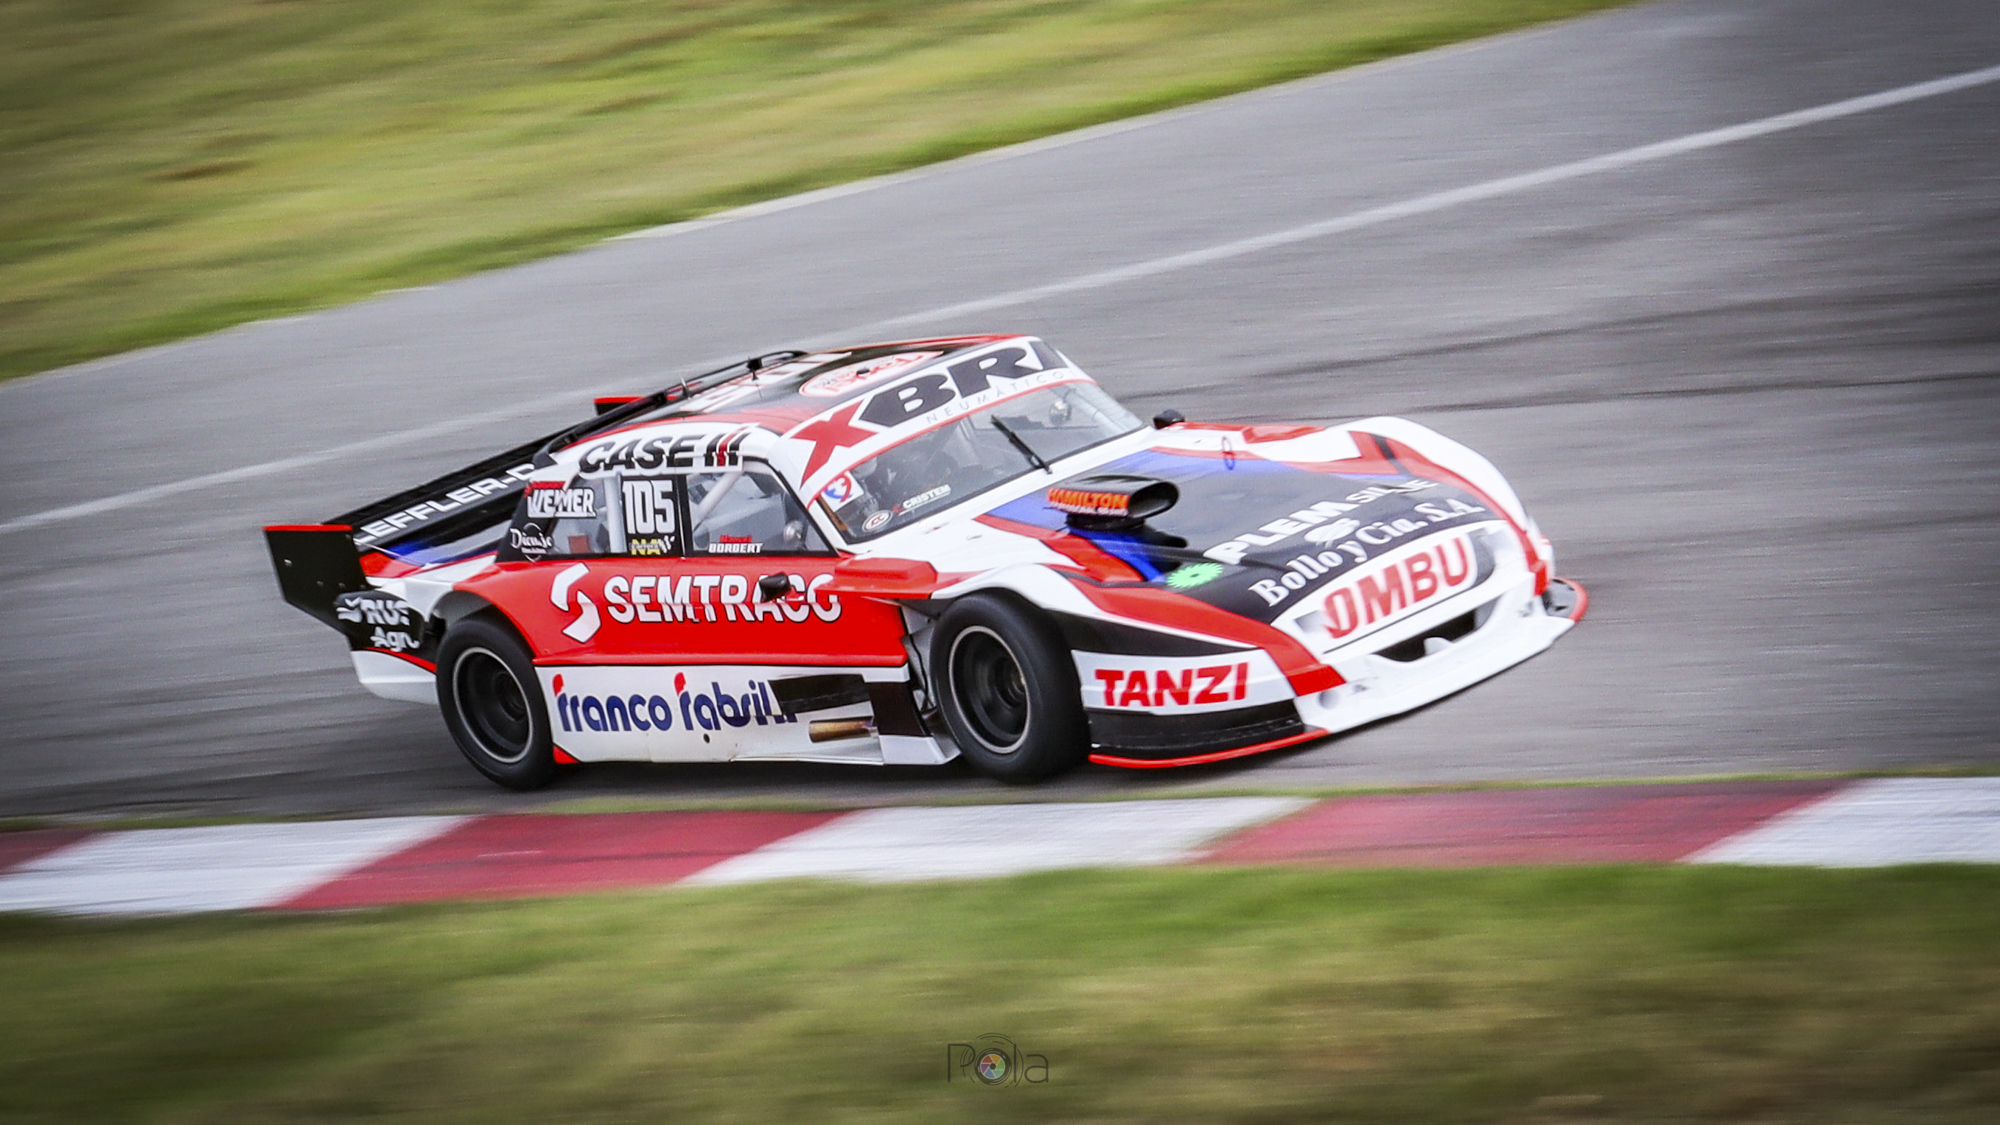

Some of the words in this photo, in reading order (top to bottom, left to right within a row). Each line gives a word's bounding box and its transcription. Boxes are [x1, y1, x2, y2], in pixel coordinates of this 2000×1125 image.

[792, 341, 1068, 489] XBRI
[926, 368, 1079, 424] NEUMÁTICO
[579, 434, 705, 473] CASE
[622, 480, 675, 534] 105
[1046, 487, 1130, 509] HAMILTON
[1203, 501, 1360, 565] PLEM
[1249, 550, 1343, 607] Bollo
[1337, 540, 1368, 562] y
[1323, 536, 1469, 639] OMBU
[1095, 662, 1248, 707] TANZI
